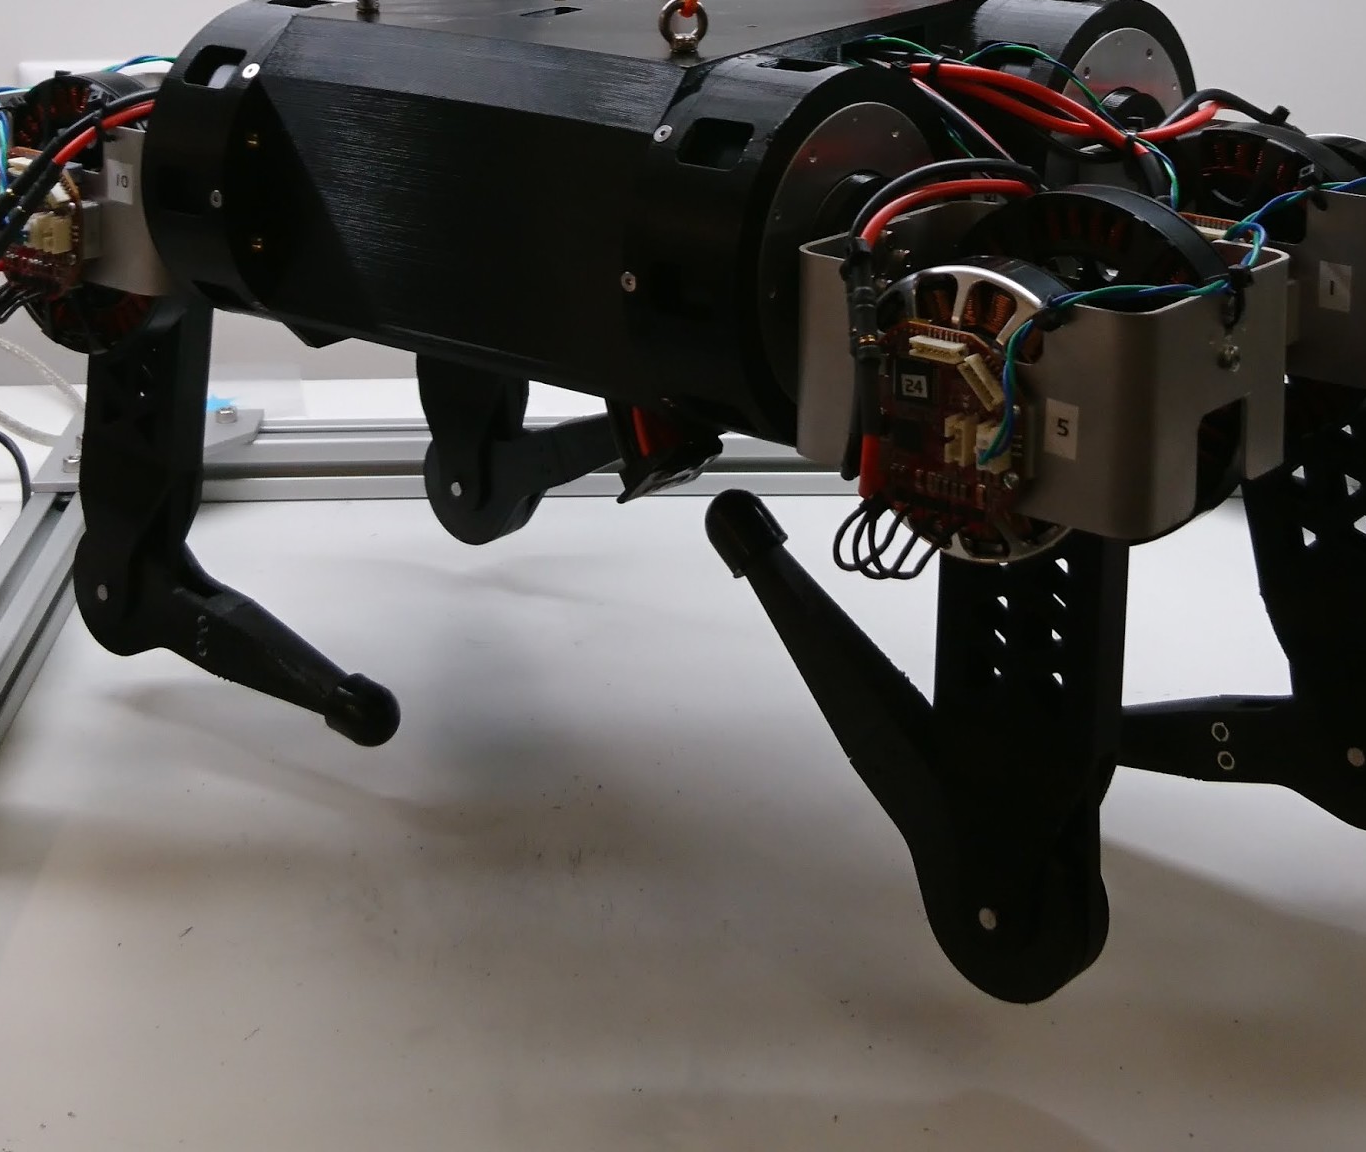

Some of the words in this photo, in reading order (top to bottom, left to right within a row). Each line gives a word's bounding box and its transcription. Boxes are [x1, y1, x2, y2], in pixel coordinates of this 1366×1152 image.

[116, 174, 129, 188] 10
[904, 378, 923, 393] 24
[1056, 418, 1070, 437] 5
